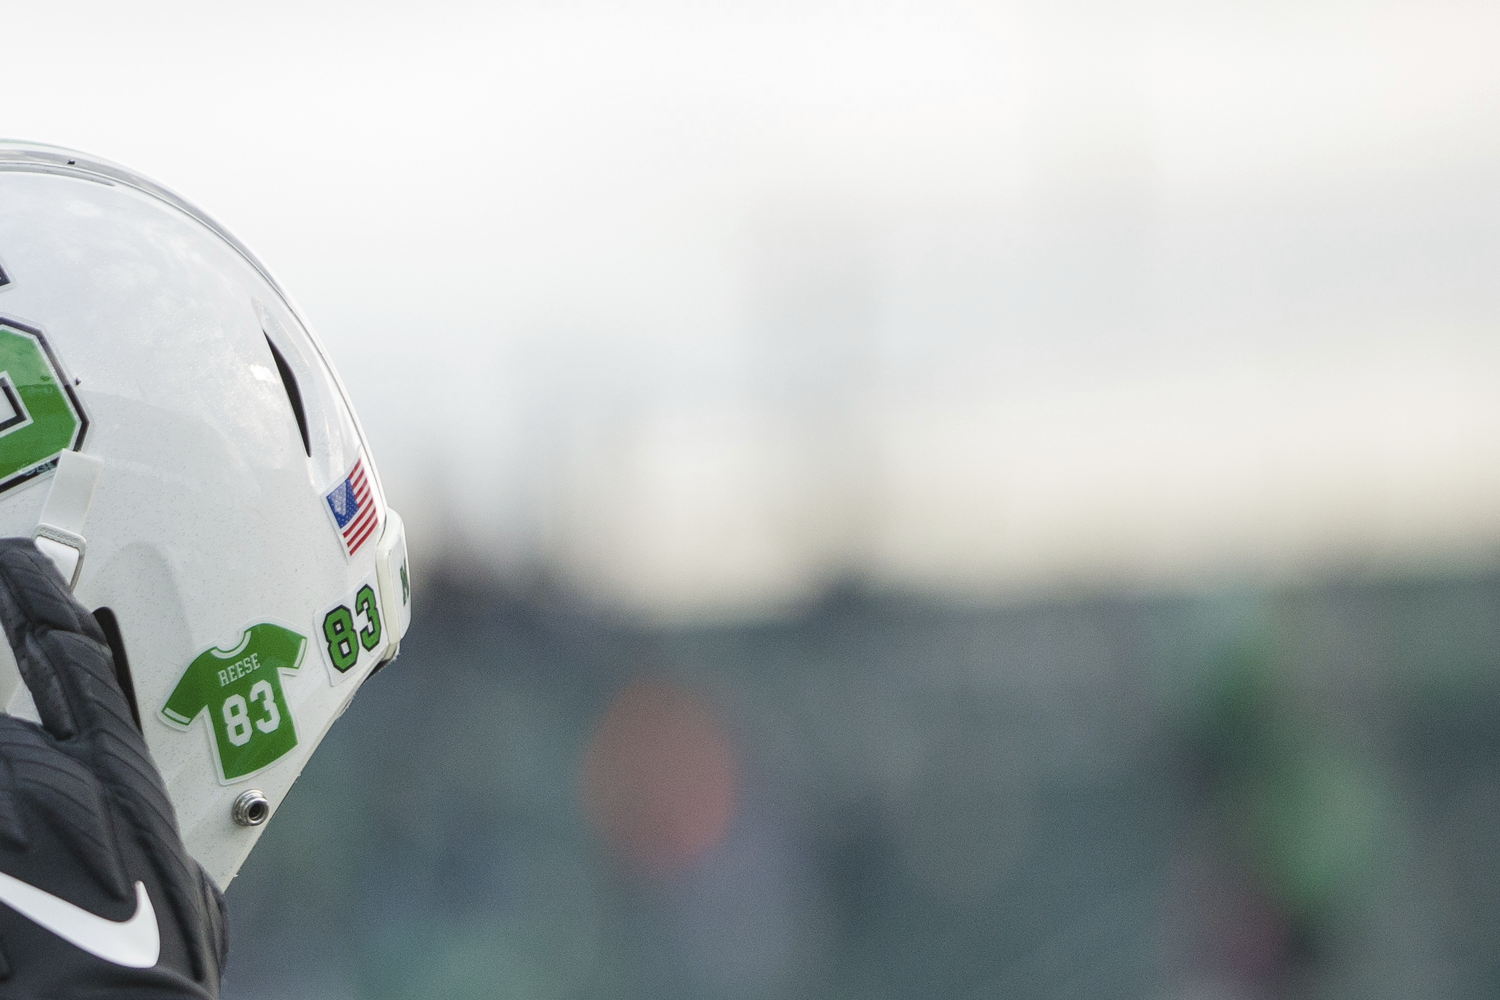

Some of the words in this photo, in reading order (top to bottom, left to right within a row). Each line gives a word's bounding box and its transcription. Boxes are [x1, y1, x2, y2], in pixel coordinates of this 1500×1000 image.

[322, 584, 382, 673] 83
[219, 653, 261, 686] REESE
[222, 680, 281, 747] 83
